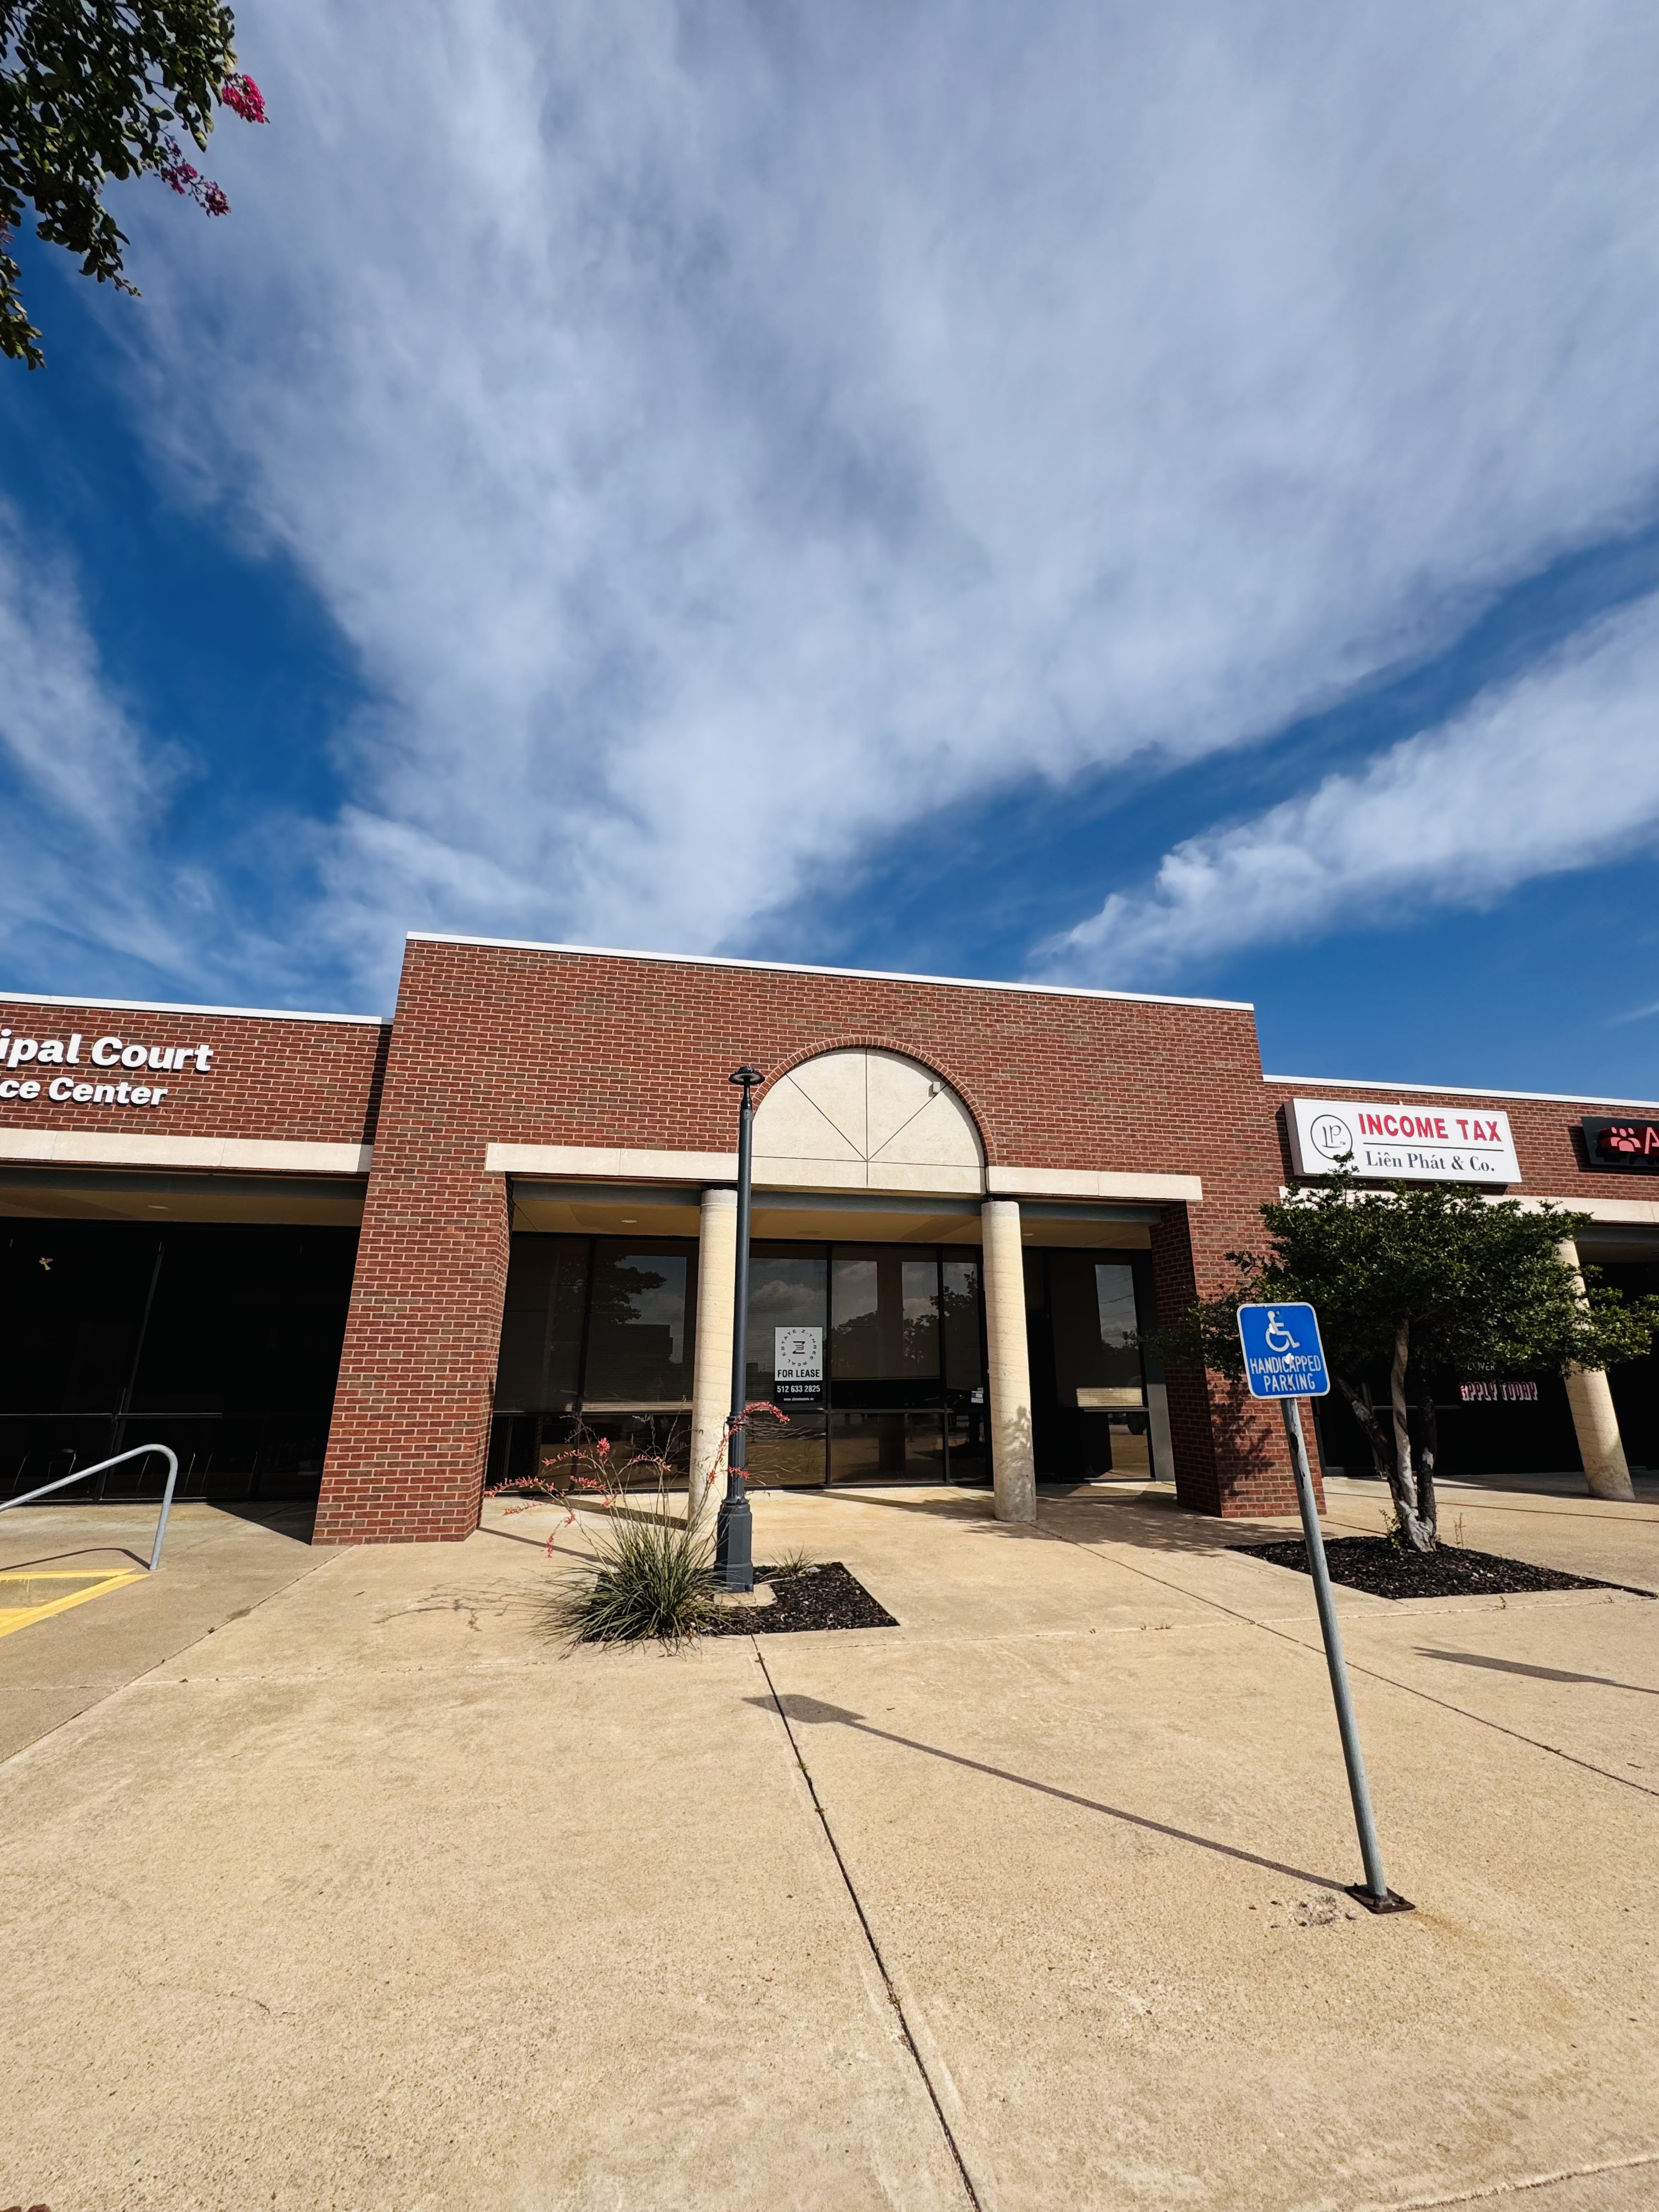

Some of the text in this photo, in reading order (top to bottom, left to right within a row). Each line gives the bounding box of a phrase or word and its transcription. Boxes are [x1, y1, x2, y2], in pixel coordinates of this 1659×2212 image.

[92, 1037, 214, 1071] Court
[49, 1077, 168, 1106] Center
[1358, 1113, 1502, 1142] INCOME TAX
[1364, 1150, 1495, 1172] Liên Phát & Co.
[781, 1329, 797, 1357] ESTATE
[777, 1369, 820, 1378] FOR LEASE
[1249, 1355, 1322, 1374] HANDICAPPED
[1263, 1373, 1316, 1392] PARKING
[1499, 1381, 1538, 1401] TODAY
